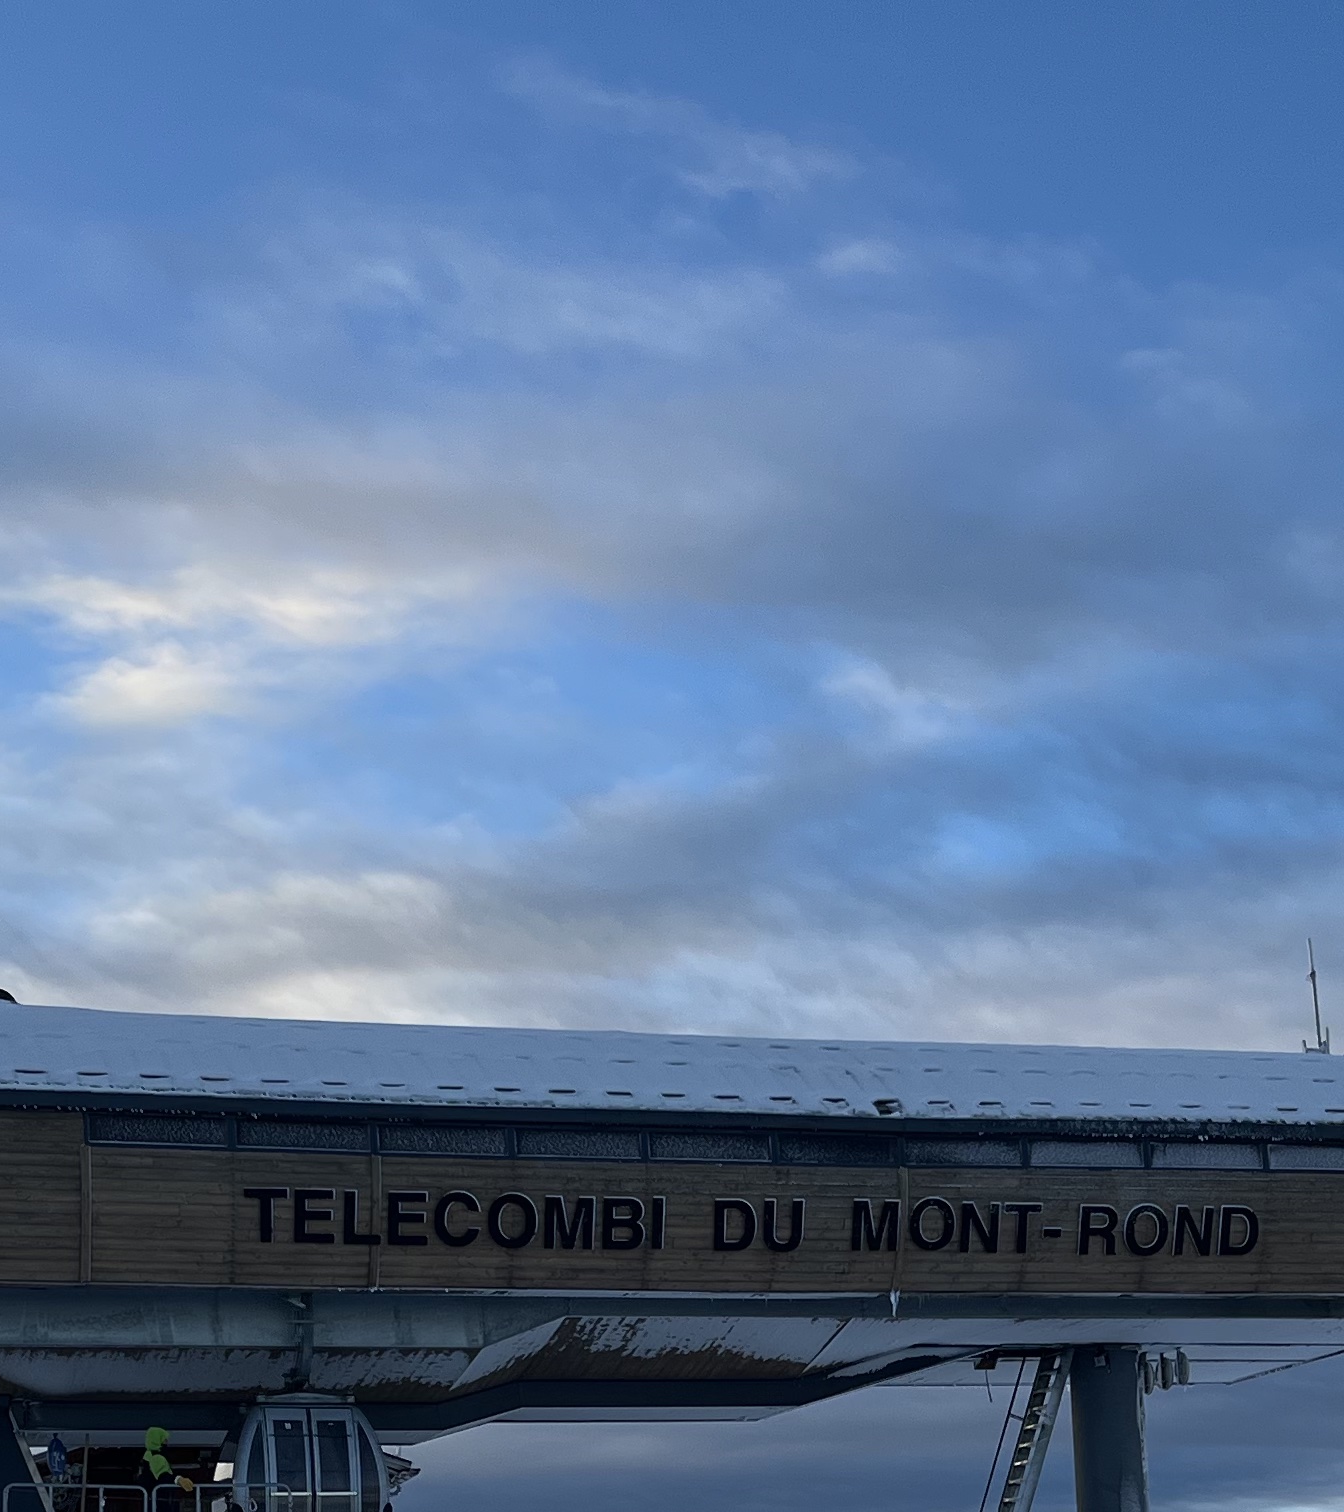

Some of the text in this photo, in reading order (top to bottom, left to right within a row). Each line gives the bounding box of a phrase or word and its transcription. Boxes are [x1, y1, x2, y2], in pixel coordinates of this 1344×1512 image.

[243, 1187, 1259, 1256] TELECOMBI DU MONT-ROND
